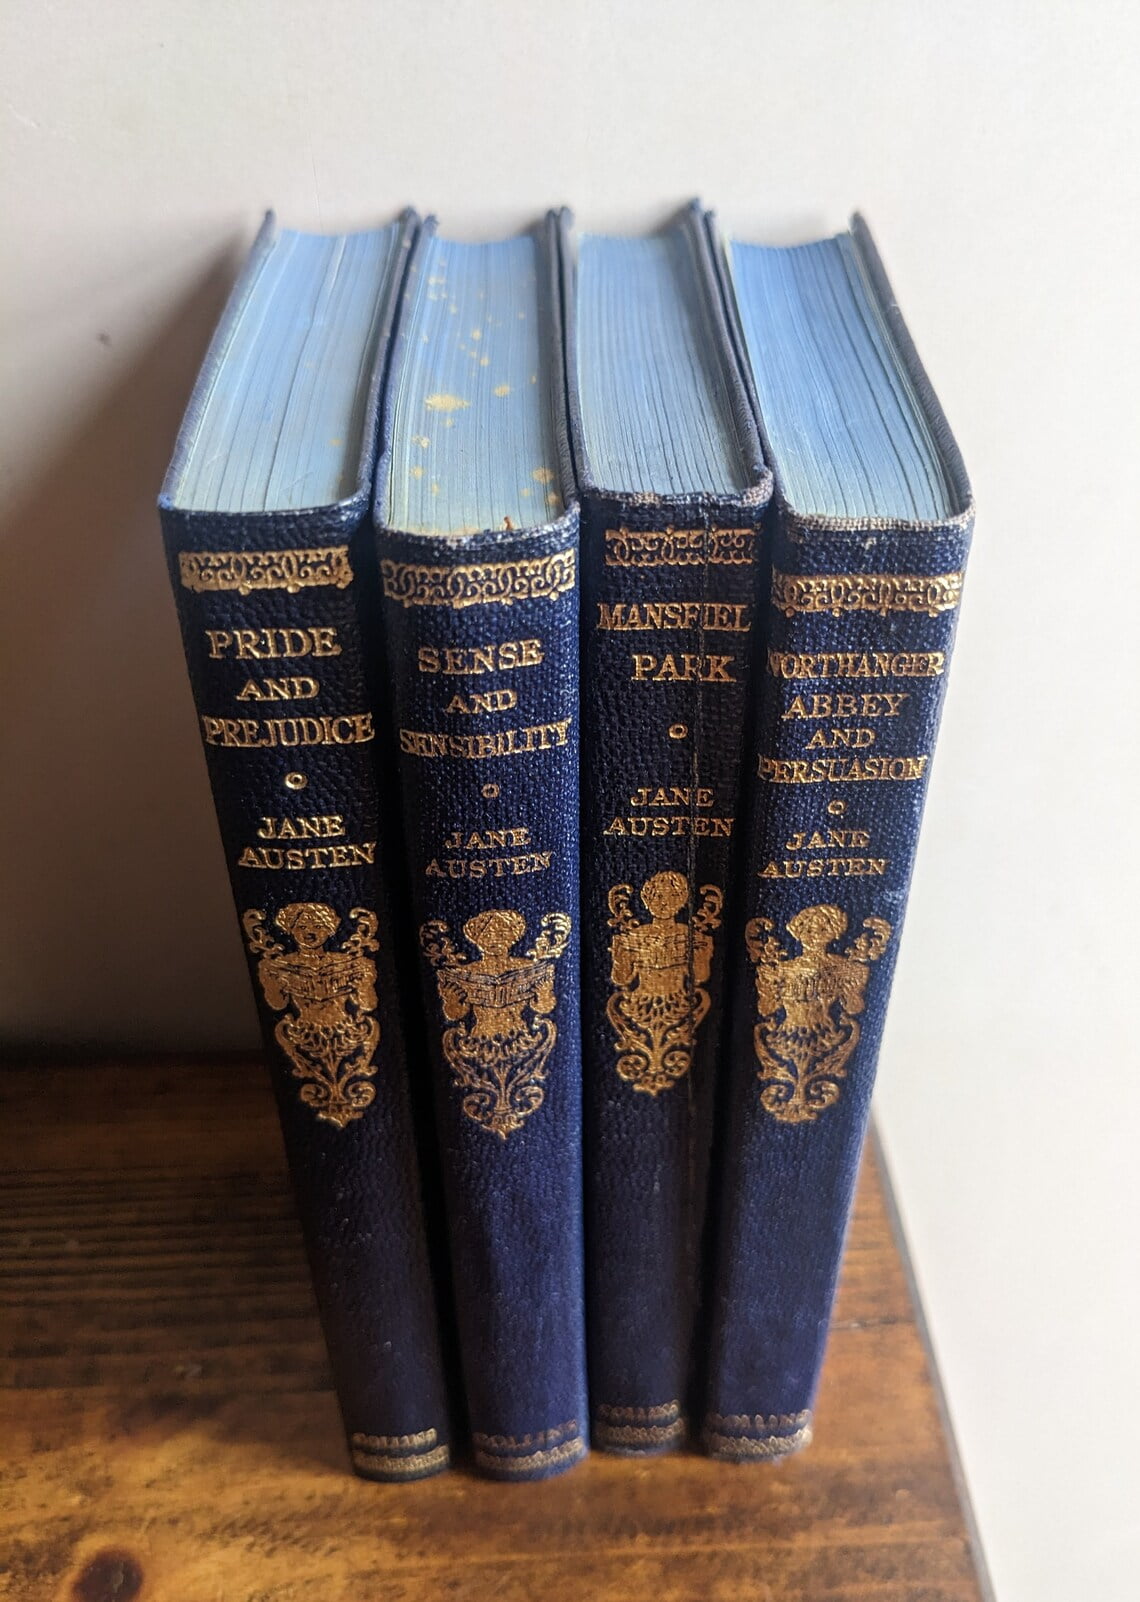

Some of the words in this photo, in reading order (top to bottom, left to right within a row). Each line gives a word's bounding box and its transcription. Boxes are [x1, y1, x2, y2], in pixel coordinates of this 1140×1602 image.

[205, 627, 342, 659] PRIDE
[418, 638, 545, 675] SENSE
[631, 654, 737, 682] PARK
[236, 677, 319, 701] AND
[445, 689, 517, 714] AND
[781, 693, 910, 719] ABBEY
[201, 712, 375, 747] PREJUDICE
[400, 716, 572, 759] SENSIBILITY
[805, 728, 876, 749] AND
[757, 754, 928, 784] PERSUASION
[630, 787, 714, 807] JANE
[257, 815, 345, 839] JANE
[444, 827, 531, 849] JANE
[603, 817, 734, 837] AUSTEN
[785, 830, 870, 850] JANE
[238, 841, 376, 869] AUSTEN
[425, 851, 554, 878] AUSTEN
[757, 858, 890, 878] AUSTEN
